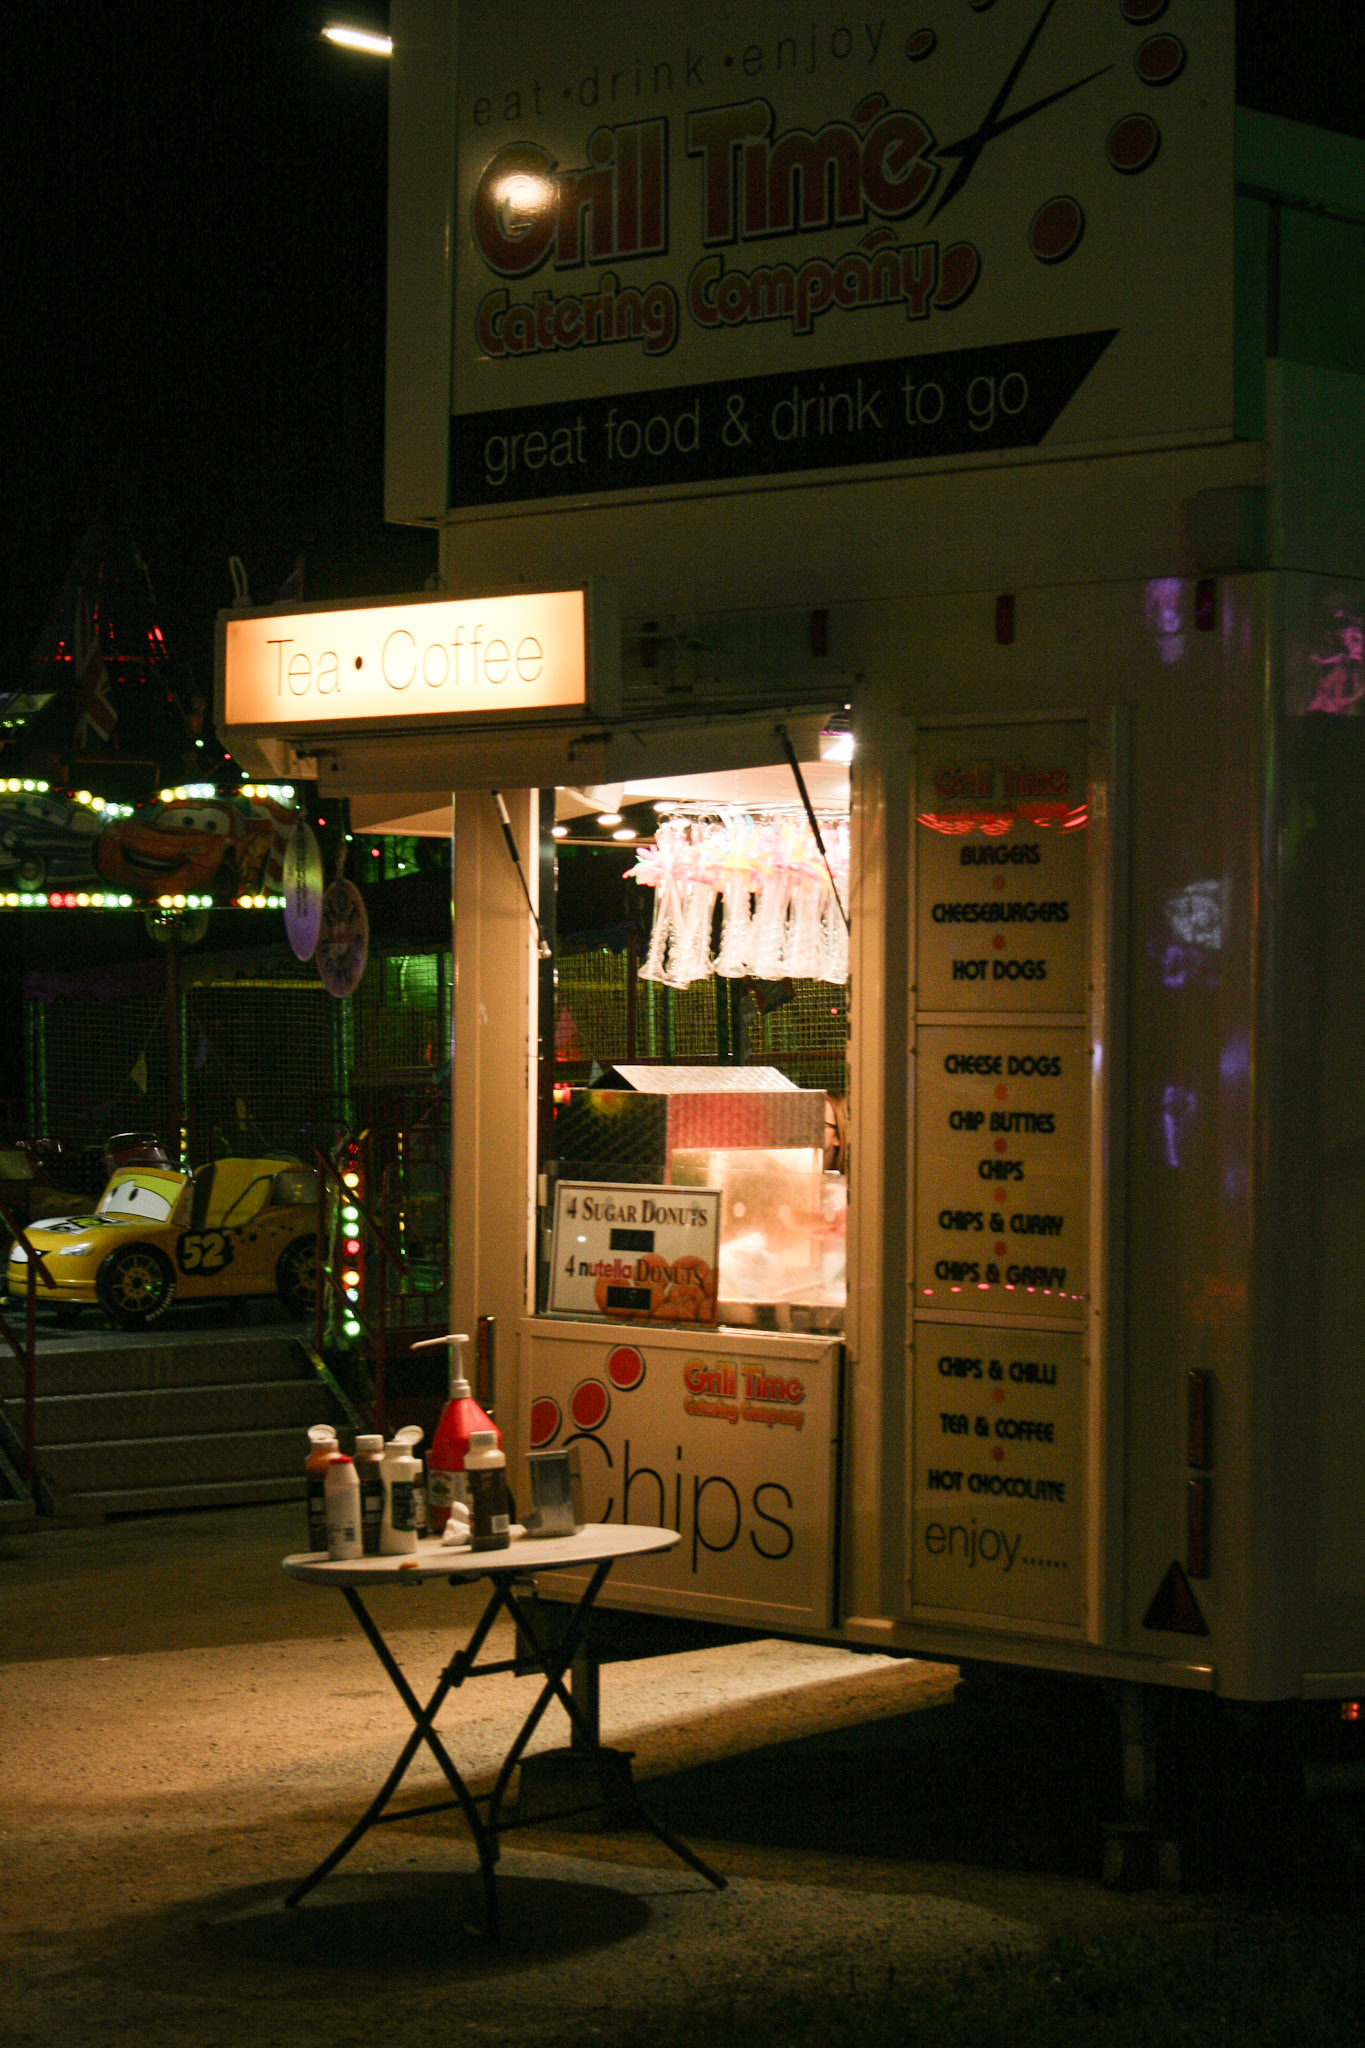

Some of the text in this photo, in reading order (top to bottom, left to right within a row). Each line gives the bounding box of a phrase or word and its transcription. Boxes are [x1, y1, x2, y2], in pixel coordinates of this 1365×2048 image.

[472, 20, 886, 127] eat drink enjoy
[472, 98, 941, 279] Grill Time
[475, 227, 938, 360] Catering Company
[483, 371, 1030, 486] great food & drink to go
[266, 623, 545, 697] Tea Coffee
[959, 844, 1041, 866] BURGERS
[931, 902, 1070, 923] CHEESEBURGERS
[952, 960, 1046, 981] HOT DOGS
[945, 1054, 1061, 1077] CHEESE DOGS
[949, 1110, 1056, 1135] CHIP BUTTIES
[978, 1159, 1024, 1181] CHIPS
[566, 1197, 578, 1220] 4
[939, 1209, 1065, 1236] CHIPS & CURRY
[181, 1231, 226, 1269] 52
[564, 1254, 575, 1278] 4
[578, 1258, 633, 1280] nutella
[935, 1260, 1068, 1288] CHIPS & GRAVY
[683, 1360, 806, 1407] Grill Time
[938, 1356, 1057, 1385] CHIPS & CHILLI
[939, 1413, 1055, 1443] TEA & COFFEE
[927, 1468, 1067, 1503] HOT CHOCOLATE
